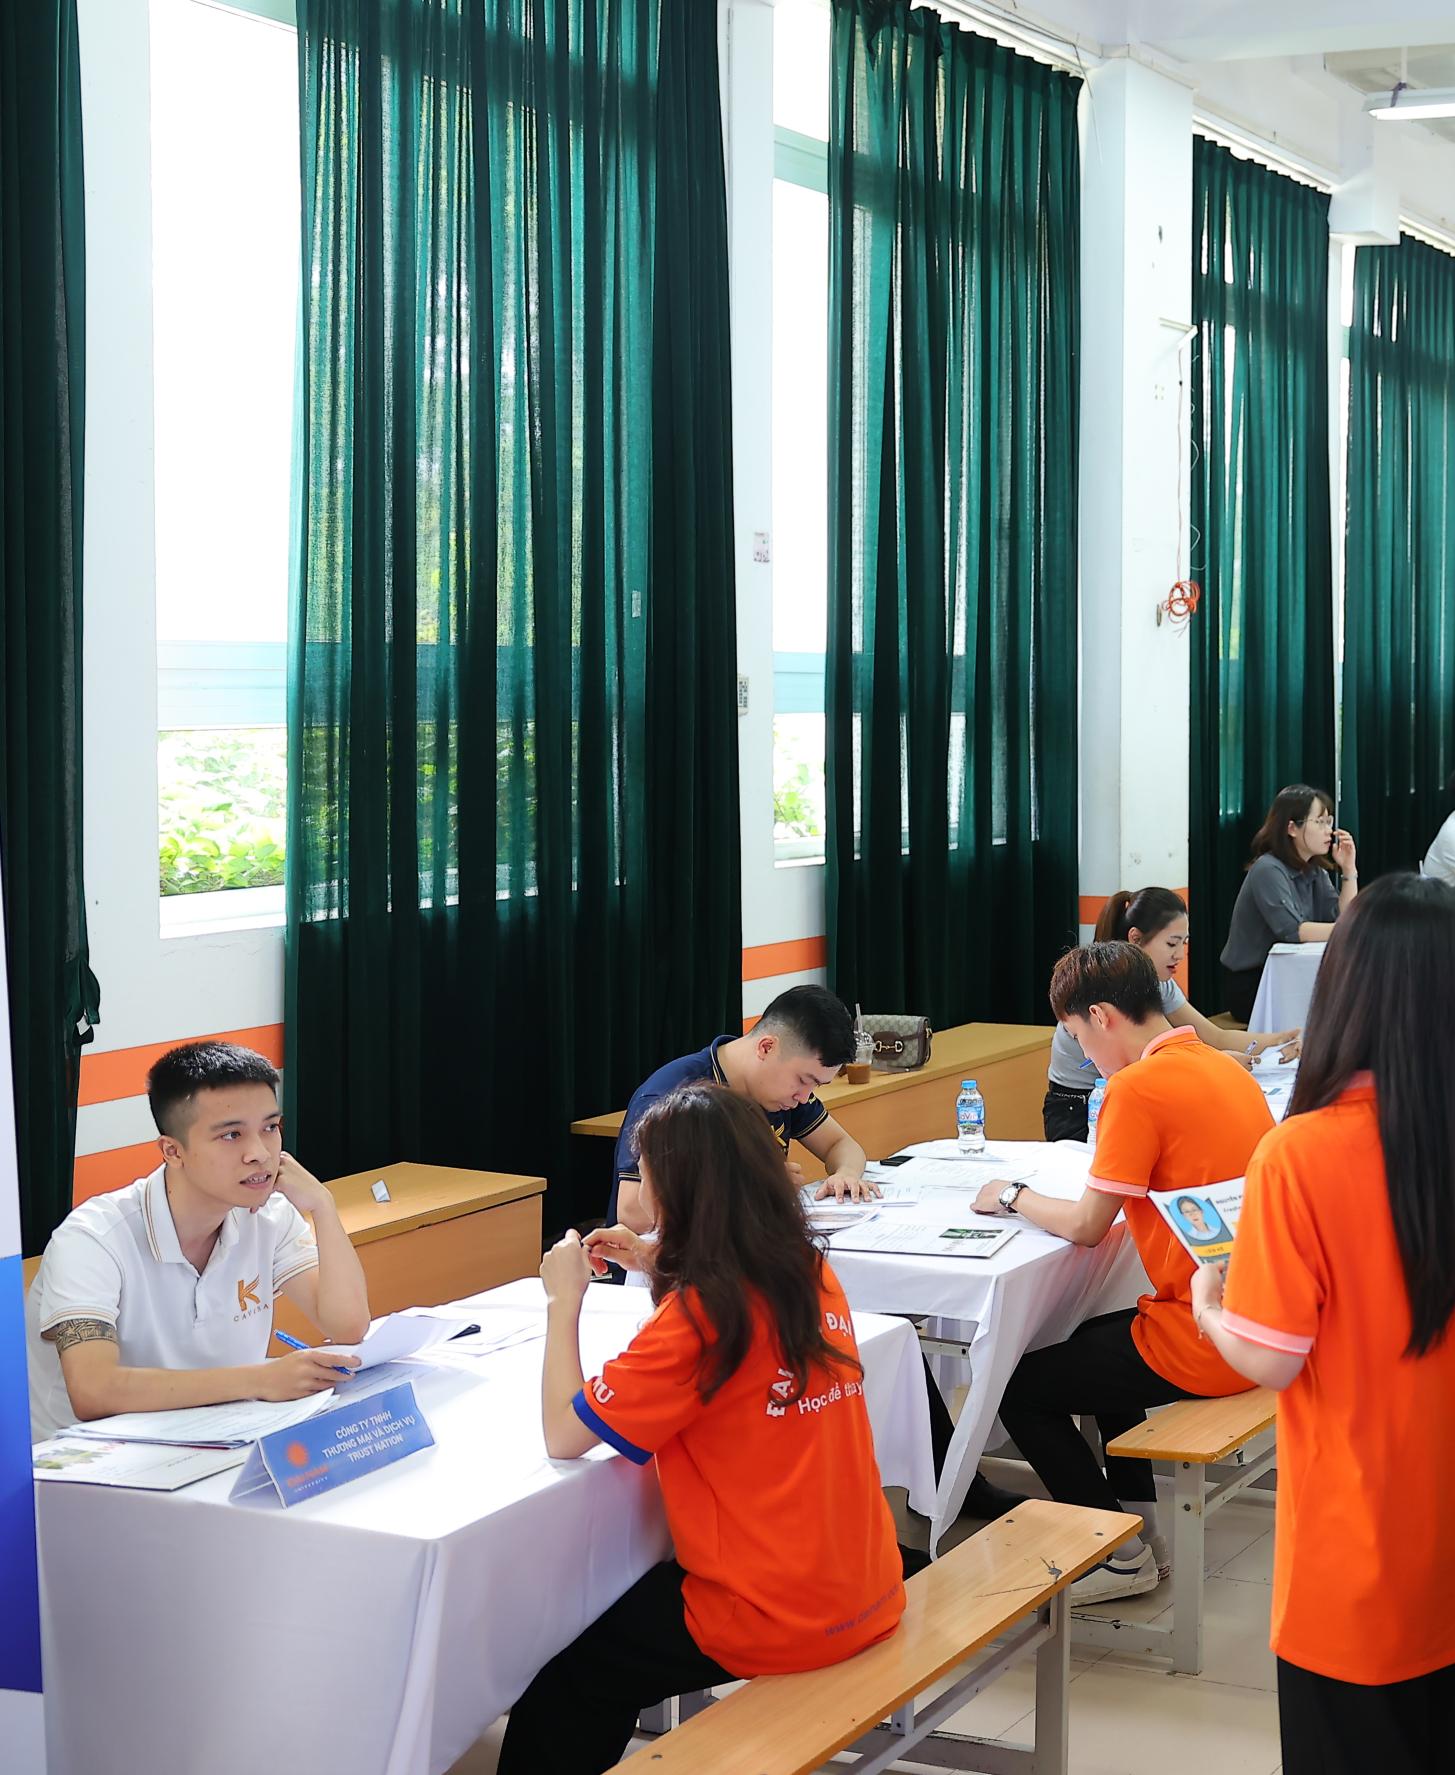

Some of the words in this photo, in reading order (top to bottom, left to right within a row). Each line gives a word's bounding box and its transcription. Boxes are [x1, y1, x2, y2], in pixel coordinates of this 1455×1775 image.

[825, 1312, 853, 1336] ĐẠI
[798, 1395, 828, 1415] Học
[828, 1381, 842, 1403] để
[335, 1423, 359, 1439] CÔNG
[358, 1418, 369, 1431] TY
[369, 1410, 392, 1426] TNHH
[356, 1431, 373, 1446] MẠI
[371, 1425, 386, 1439] VÀ
[383, 1418, 404, 1434] DỊCH
[402, 1414, 416, 1426] VỤ
[347, 1445, 374, 1463] TRUST
[373, 1433, 404, 1453] NATION
